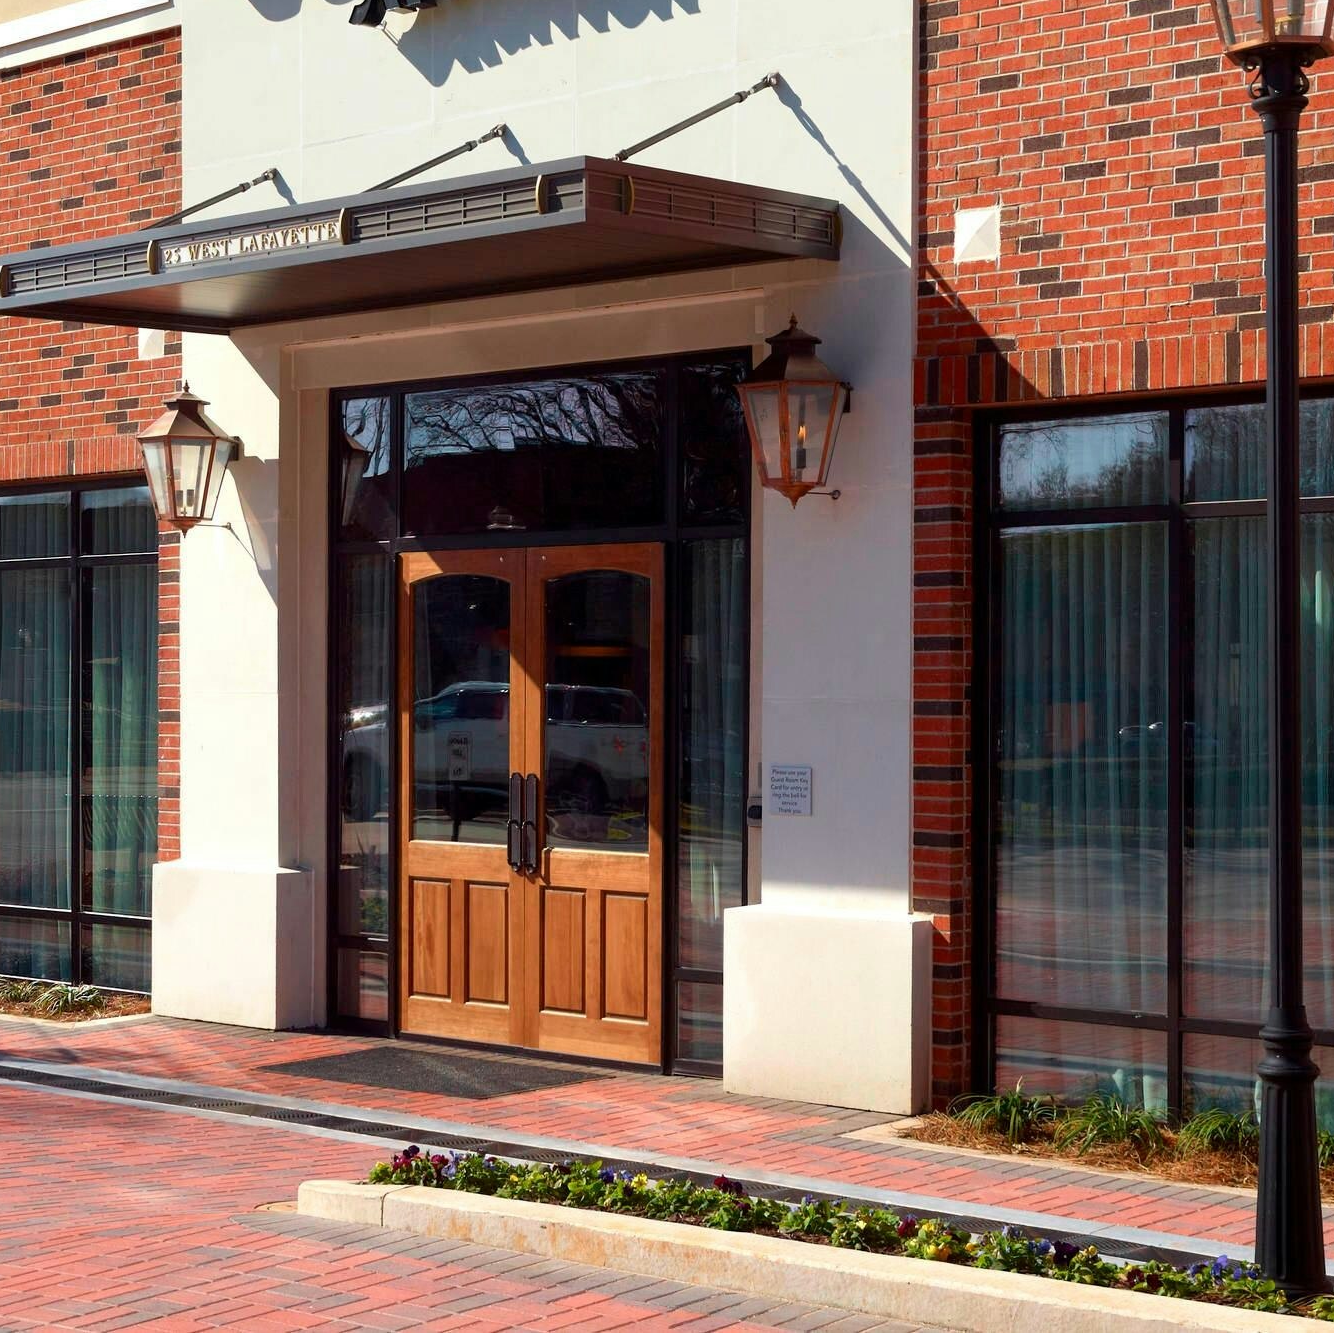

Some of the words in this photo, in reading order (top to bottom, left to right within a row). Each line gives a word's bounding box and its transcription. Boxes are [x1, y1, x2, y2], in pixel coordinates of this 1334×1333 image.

[165, 247, 181, 264] 25
[187, 239, 232, 261] WEST
[239, 221, 340, 254] LAFAYETTE
